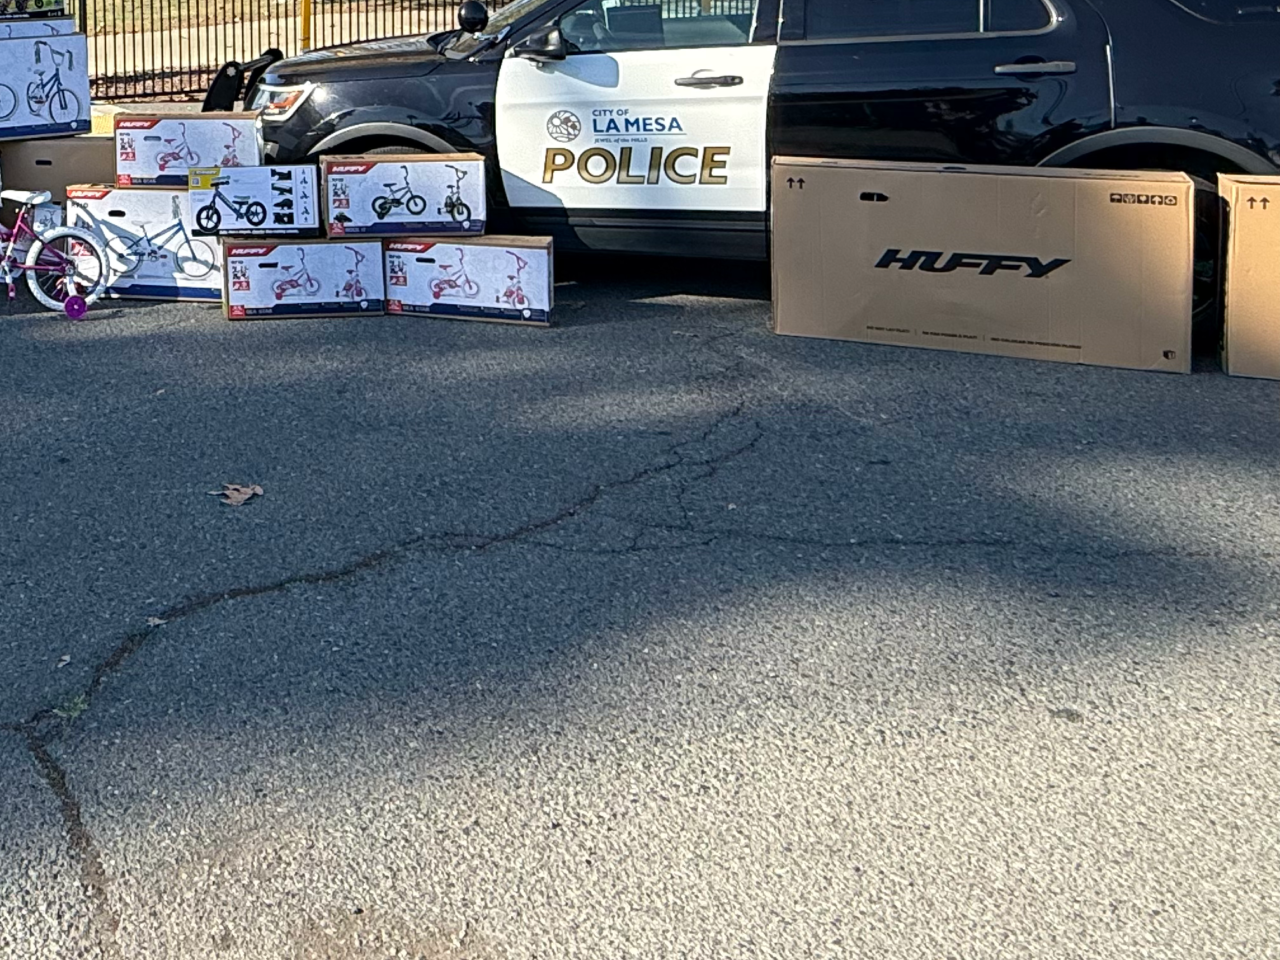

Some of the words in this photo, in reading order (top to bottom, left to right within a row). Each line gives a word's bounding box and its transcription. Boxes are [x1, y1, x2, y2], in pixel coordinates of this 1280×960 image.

[592, 109, 614, 117] CITY
[592, 118, 621, 133] LA
[624, 117, 683, 132] MESA
[541, 146, 731, 185] POLICE
[71, 190, 102, 198] HUFFY
[389, 243, 425, 251] HUFFY
[874, 248, 1072, 278] HUFFY
